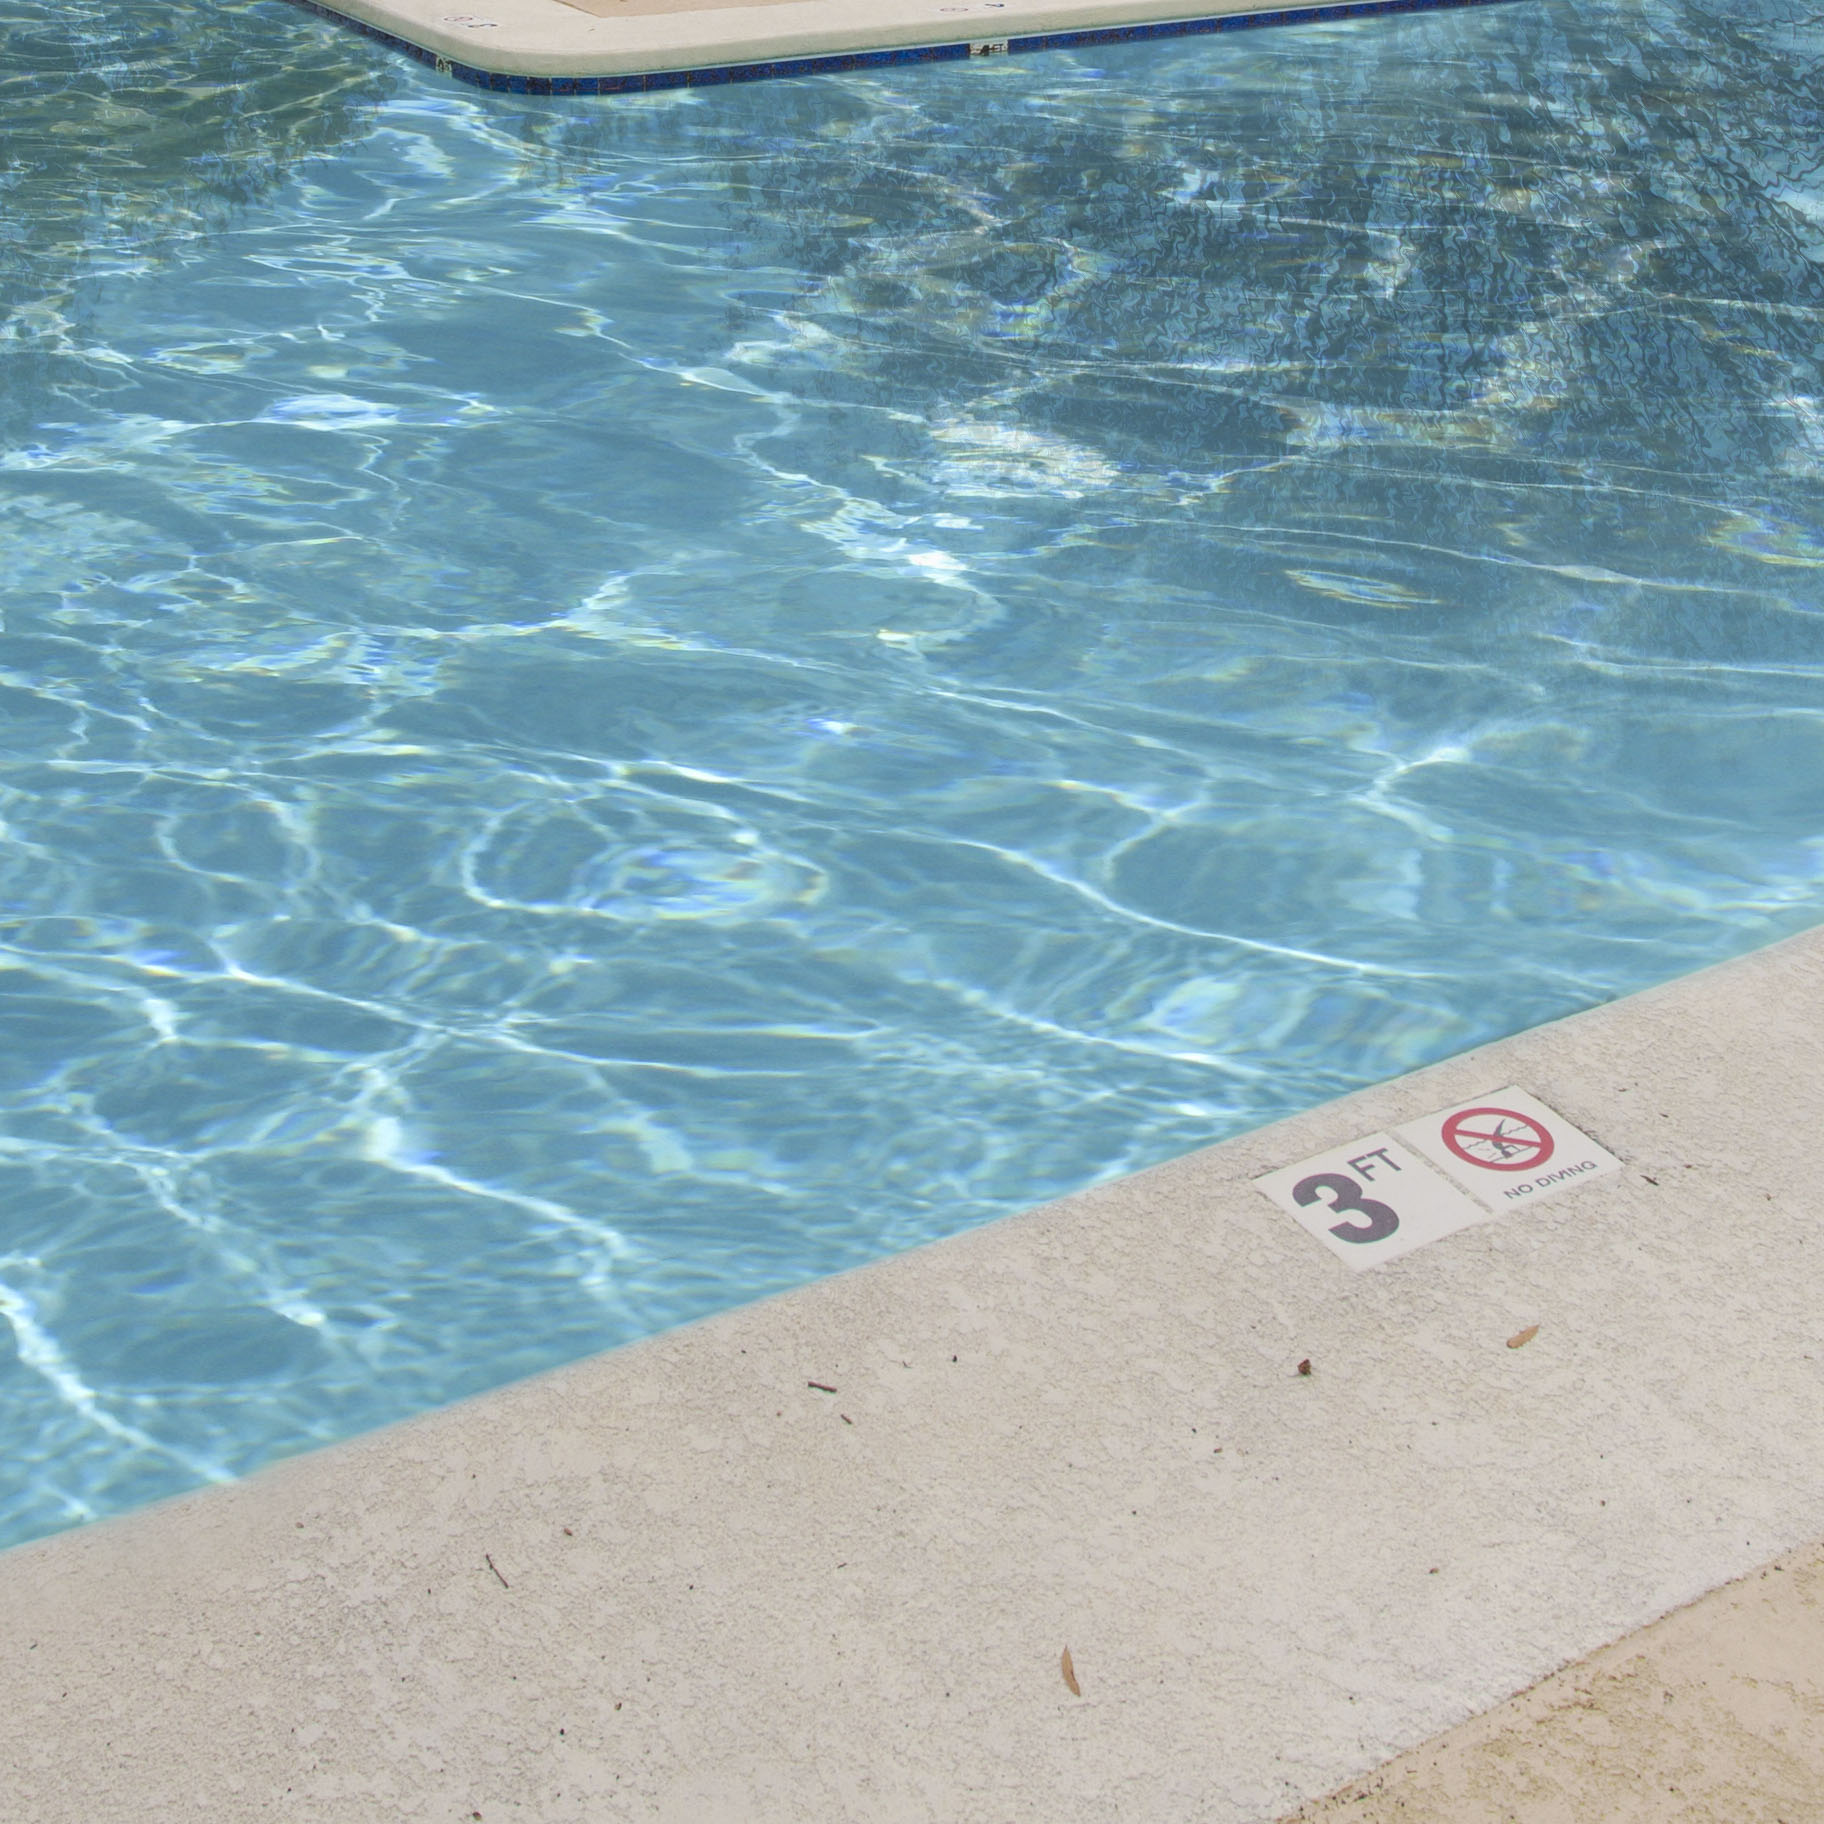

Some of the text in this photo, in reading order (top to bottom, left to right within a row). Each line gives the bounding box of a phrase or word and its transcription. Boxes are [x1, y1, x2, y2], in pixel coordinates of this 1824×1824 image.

[1291, 1147, 1403, 1244] 3 FT
[1503, 1160, 1599, 1200] NO DIVING
